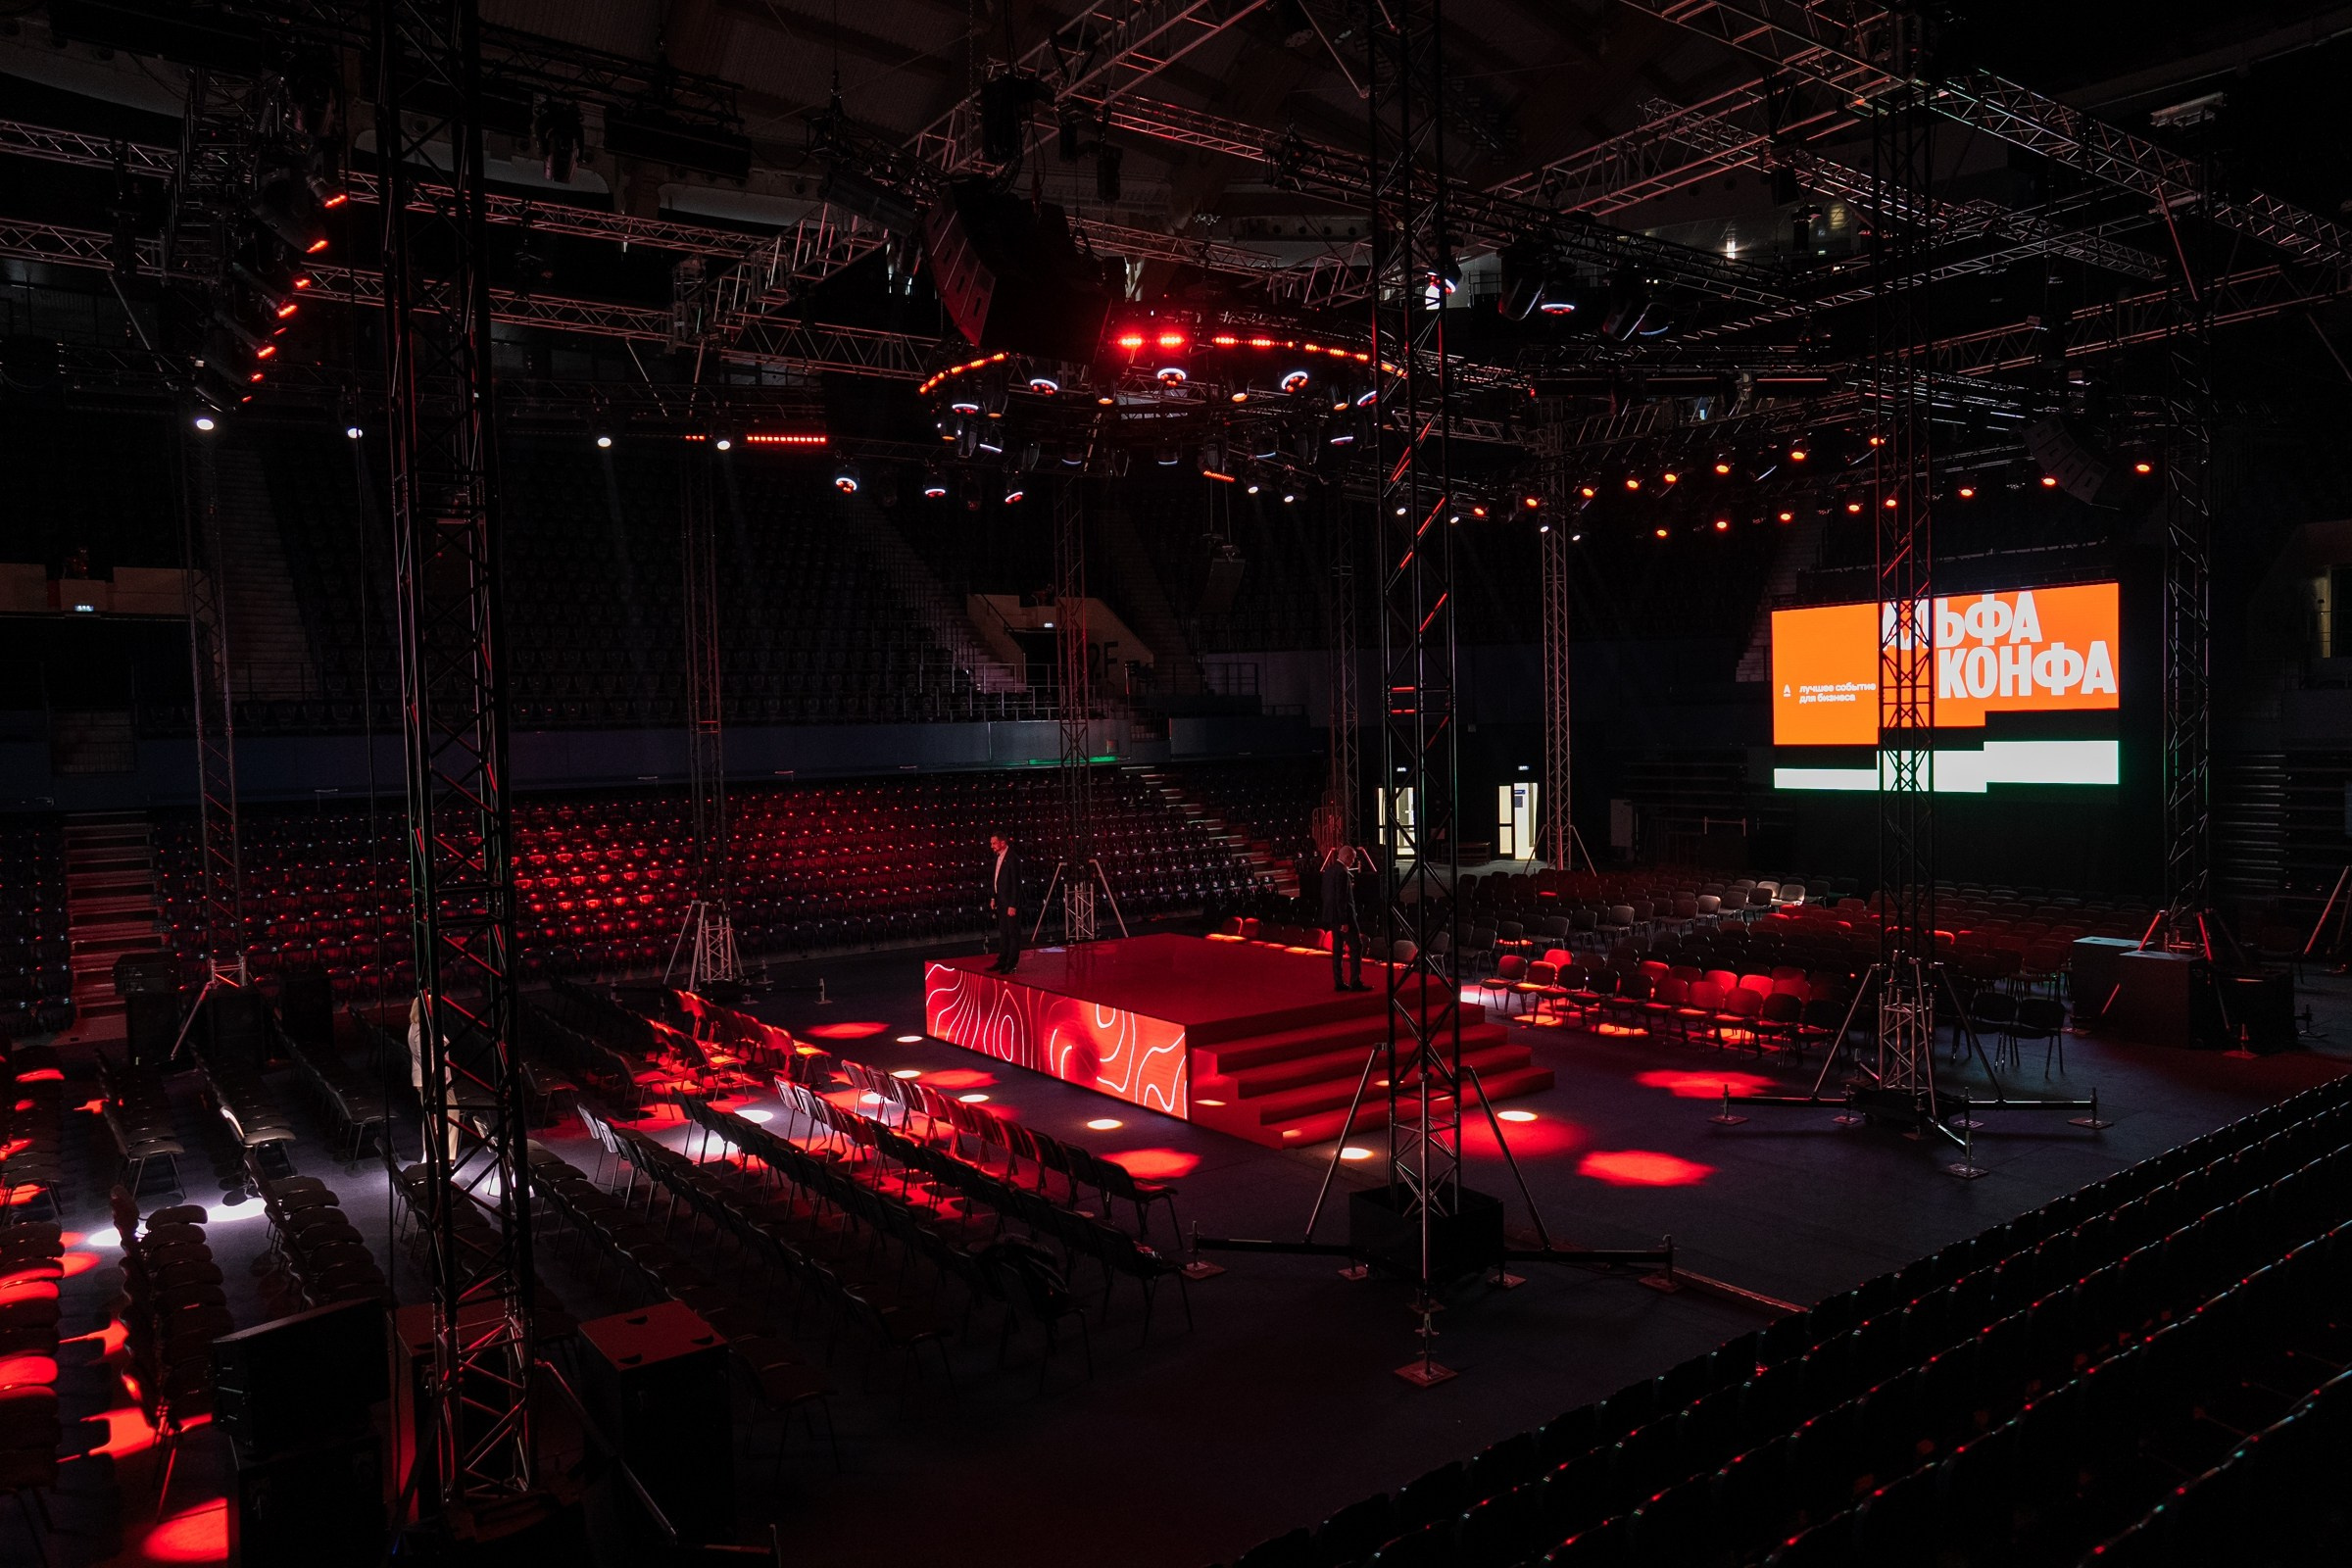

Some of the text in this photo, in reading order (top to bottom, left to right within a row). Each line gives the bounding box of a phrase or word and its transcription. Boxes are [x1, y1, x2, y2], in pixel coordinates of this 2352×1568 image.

[1938, 640, 2117, 699] КОНФА
[1799, 681, 1877, 694] лучшее событие
[1799, 693, 1856, 704] для бизнеса
